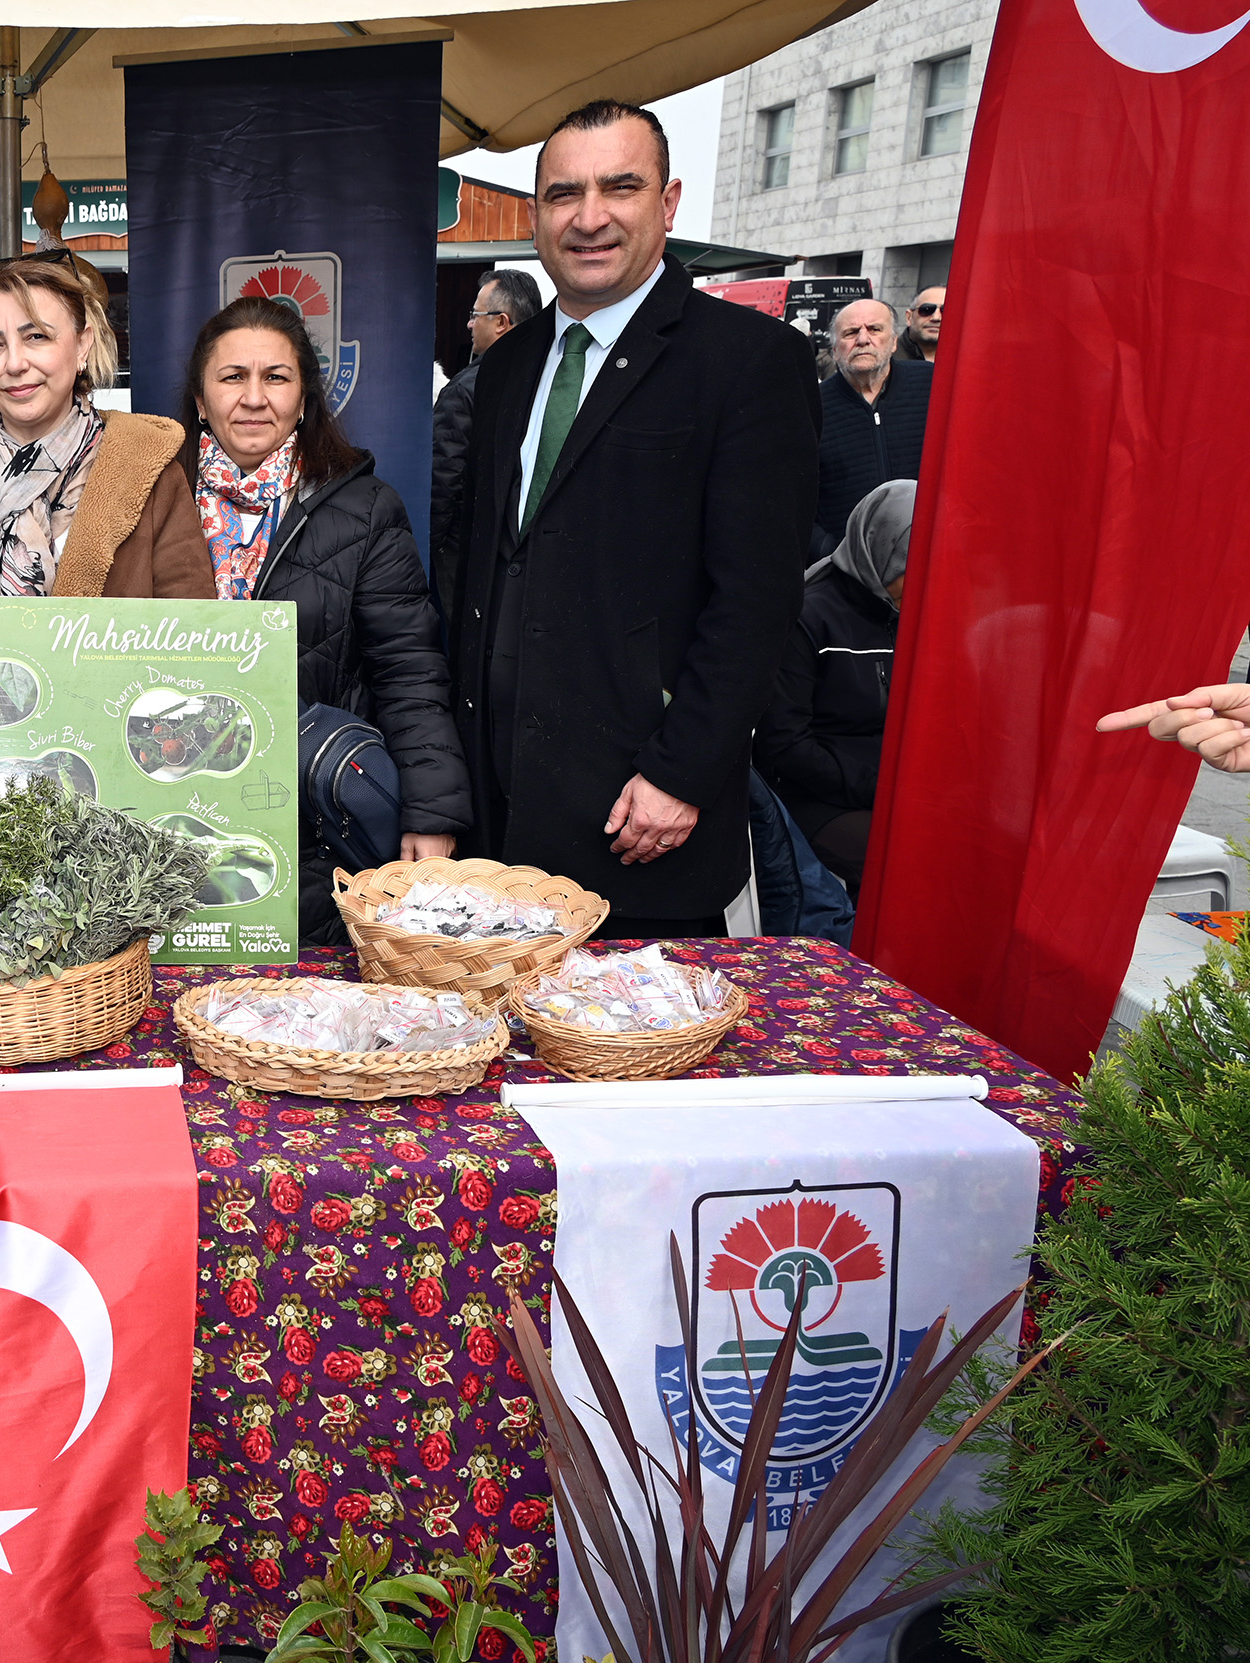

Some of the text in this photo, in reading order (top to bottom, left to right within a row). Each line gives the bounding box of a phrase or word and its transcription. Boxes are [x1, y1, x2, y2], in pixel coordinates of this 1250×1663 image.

[78, 200, 128, 223] BAĞDA
[48, 614, 269, 673] Mahsüllerimiz
[104, 653, 138, 661] BELEDİYESİ
[169, 654, 201, 662] HİZMETLER
[202, 654, 241, 663] MÜDÜRLÜĞÜ
[103, 665, 205, 718] Cherry Domates
[27, 725, 96, 751] Sivri Biber
[172, 922, 232, 932] EHMET
[247, 931, 265, 939] Doğru
[660, 1366, 735, 1477] YALOVA
